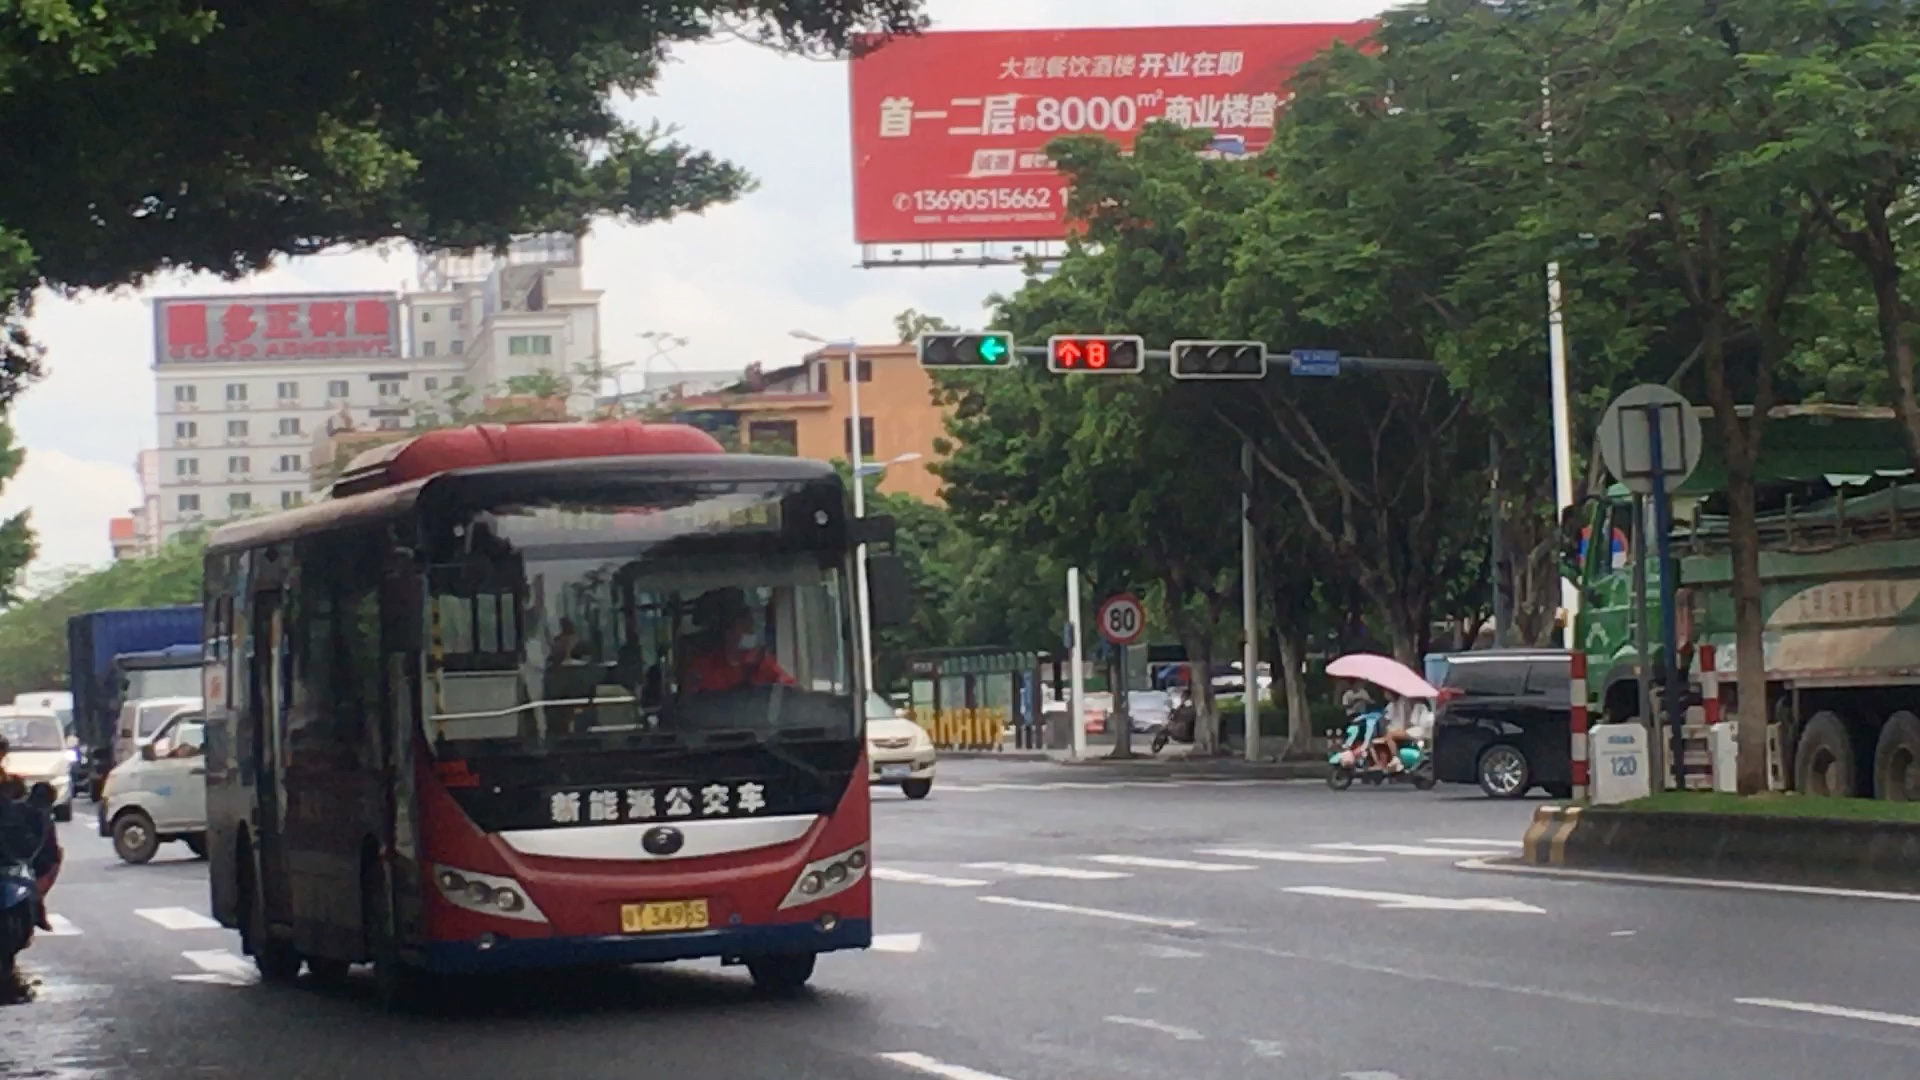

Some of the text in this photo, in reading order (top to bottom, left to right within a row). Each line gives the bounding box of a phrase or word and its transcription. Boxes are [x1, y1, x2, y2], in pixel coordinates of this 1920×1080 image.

[998, 51, 1244, 79] 大型餐饮酒楼 开业在即
[913, 188, 1051, 211] 13690515662
[1110, 608, 1135, 632] 80
[1610, 755, 1637, 776] 120
[551, 782, 766, 822] 新能源公交车
